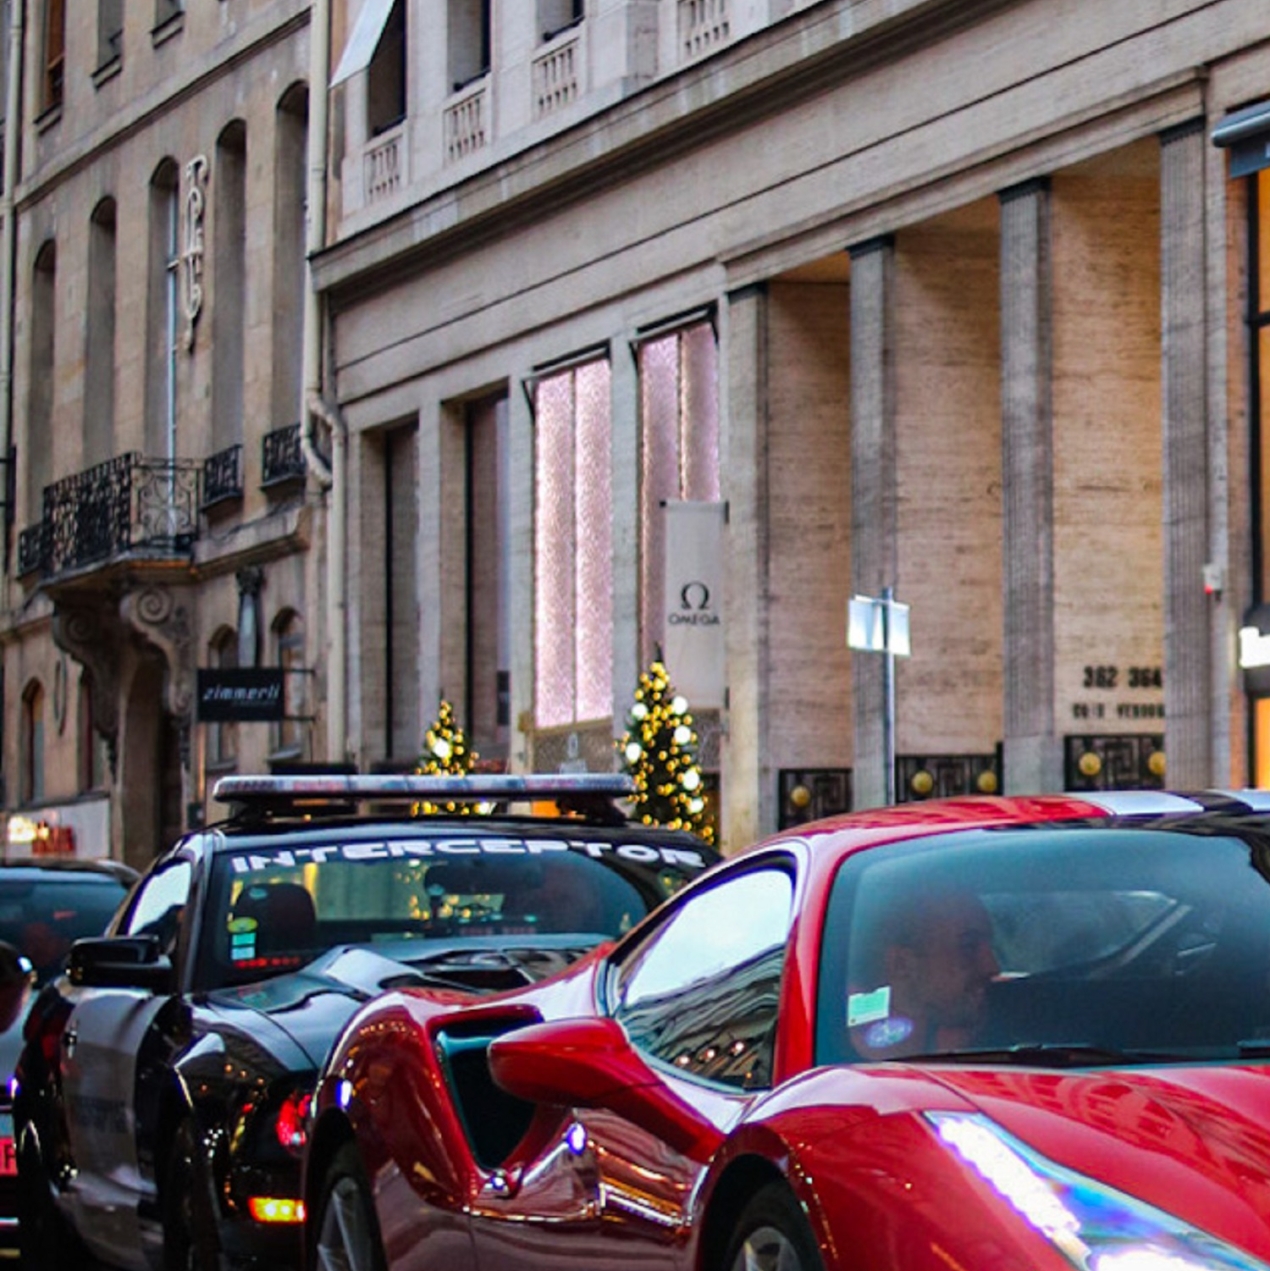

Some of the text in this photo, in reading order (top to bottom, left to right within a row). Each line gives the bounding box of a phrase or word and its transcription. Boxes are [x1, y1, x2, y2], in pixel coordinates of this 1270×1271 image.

[668, 612, 721, 627] OMEGA
[1083, 665, 1118, 689] 362
[203, 683, 281, 701] zimmerli
[231, 839, 706, 874] INTERCEPTOR
